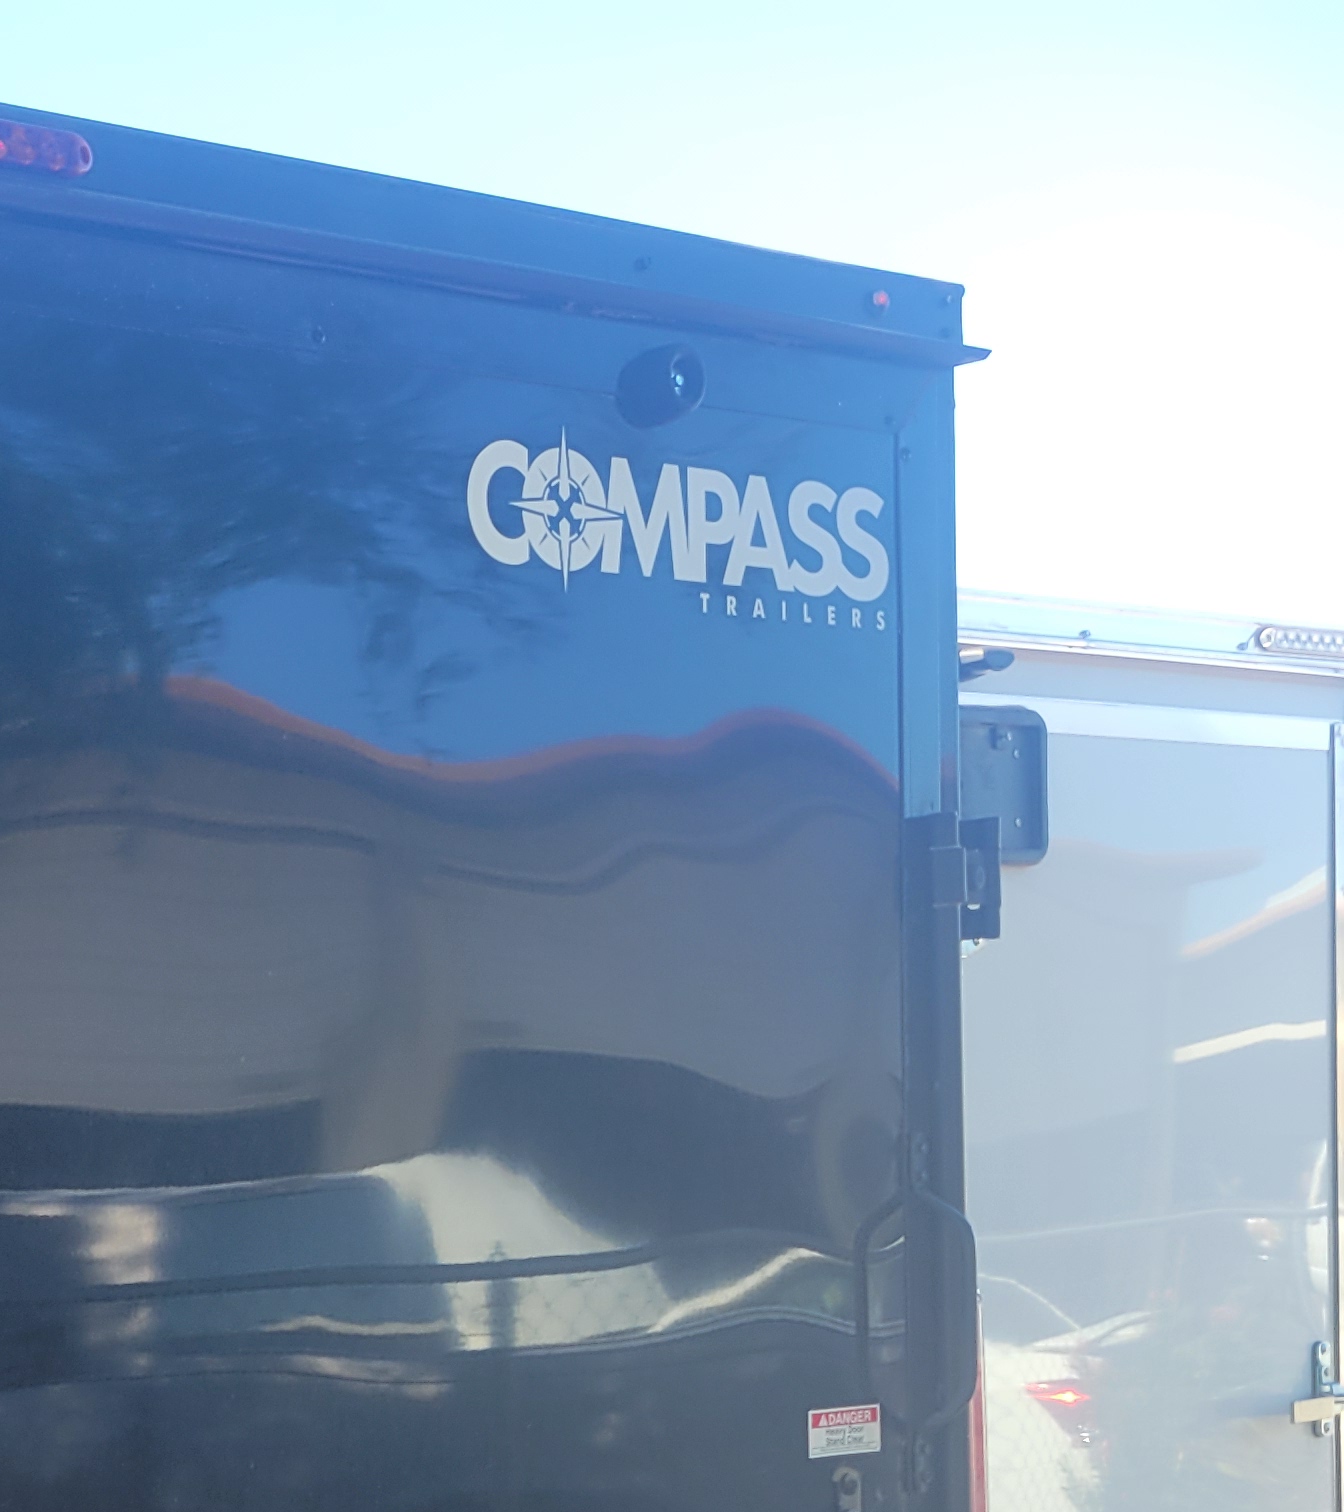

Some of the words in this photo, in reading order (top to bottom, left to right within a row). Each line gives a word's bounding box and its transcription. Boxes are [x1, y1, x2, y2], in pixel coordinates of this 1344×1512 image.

[467, 427, 890, 602] COMPASS
[699, 592, 886, 631] TRAILERS
[828, 1410, 871, 1426] DANGER
